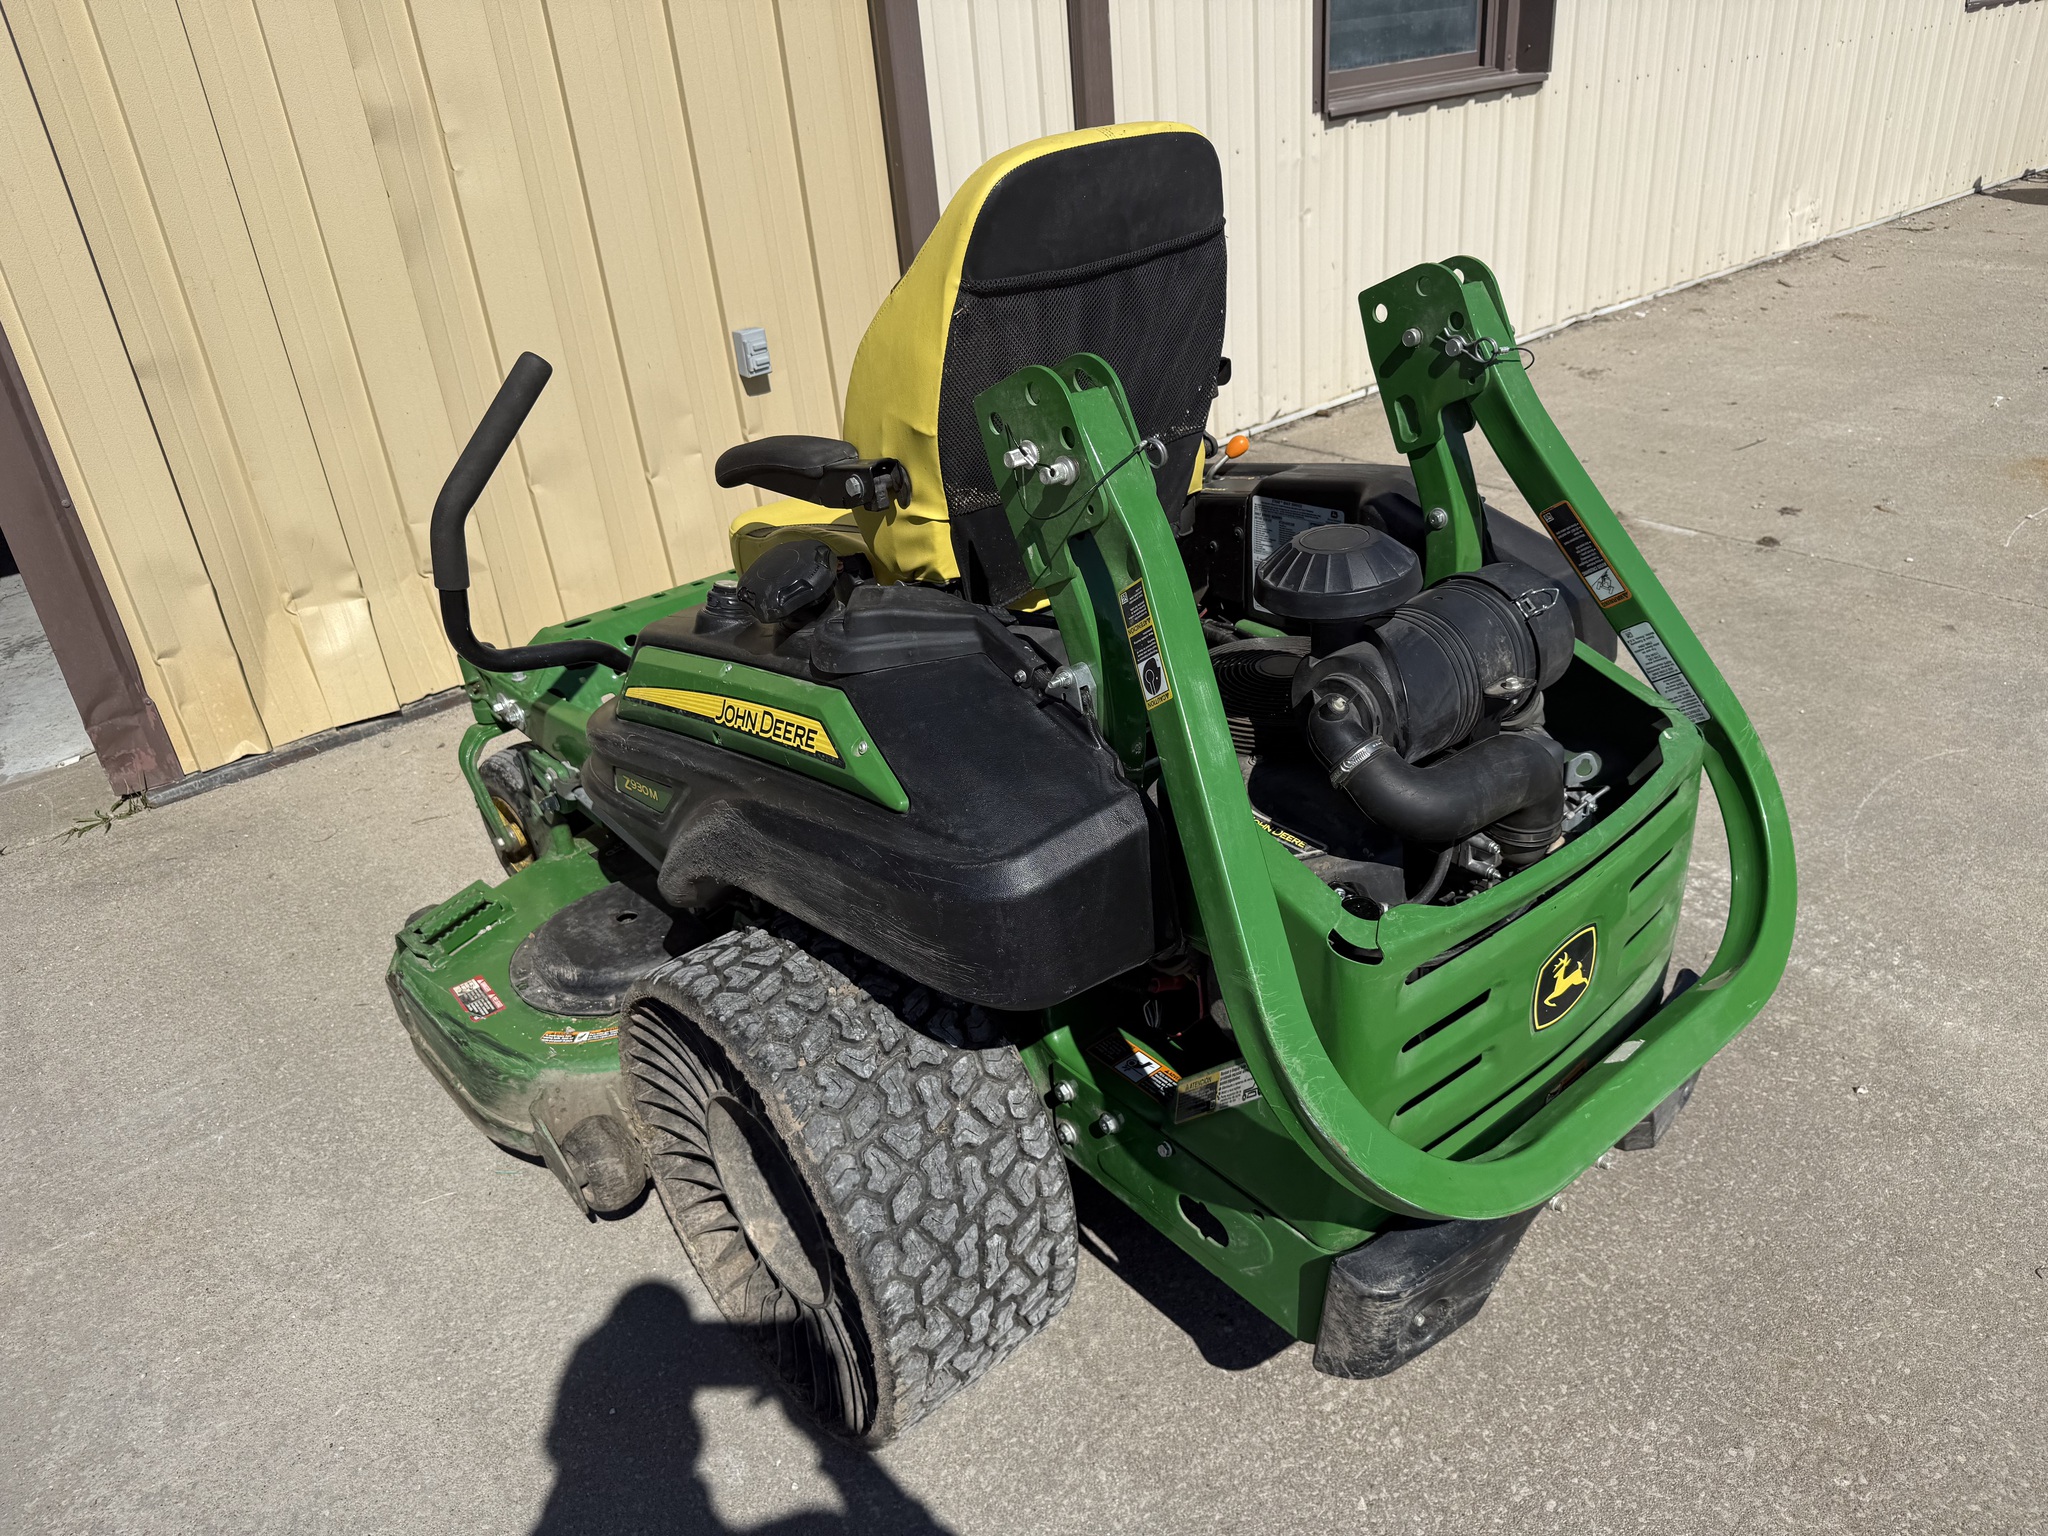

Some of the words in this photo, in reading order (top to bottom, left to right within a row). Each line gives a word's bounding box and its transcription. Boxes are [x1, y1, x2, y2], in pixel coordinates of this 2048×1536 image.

[714, 698, 758, 731] JOHN
[759, 709, 818, 750] DEERE
[622, 774, 659, 801] Z930M
[1271, 827, 1306, 849] DEERE
